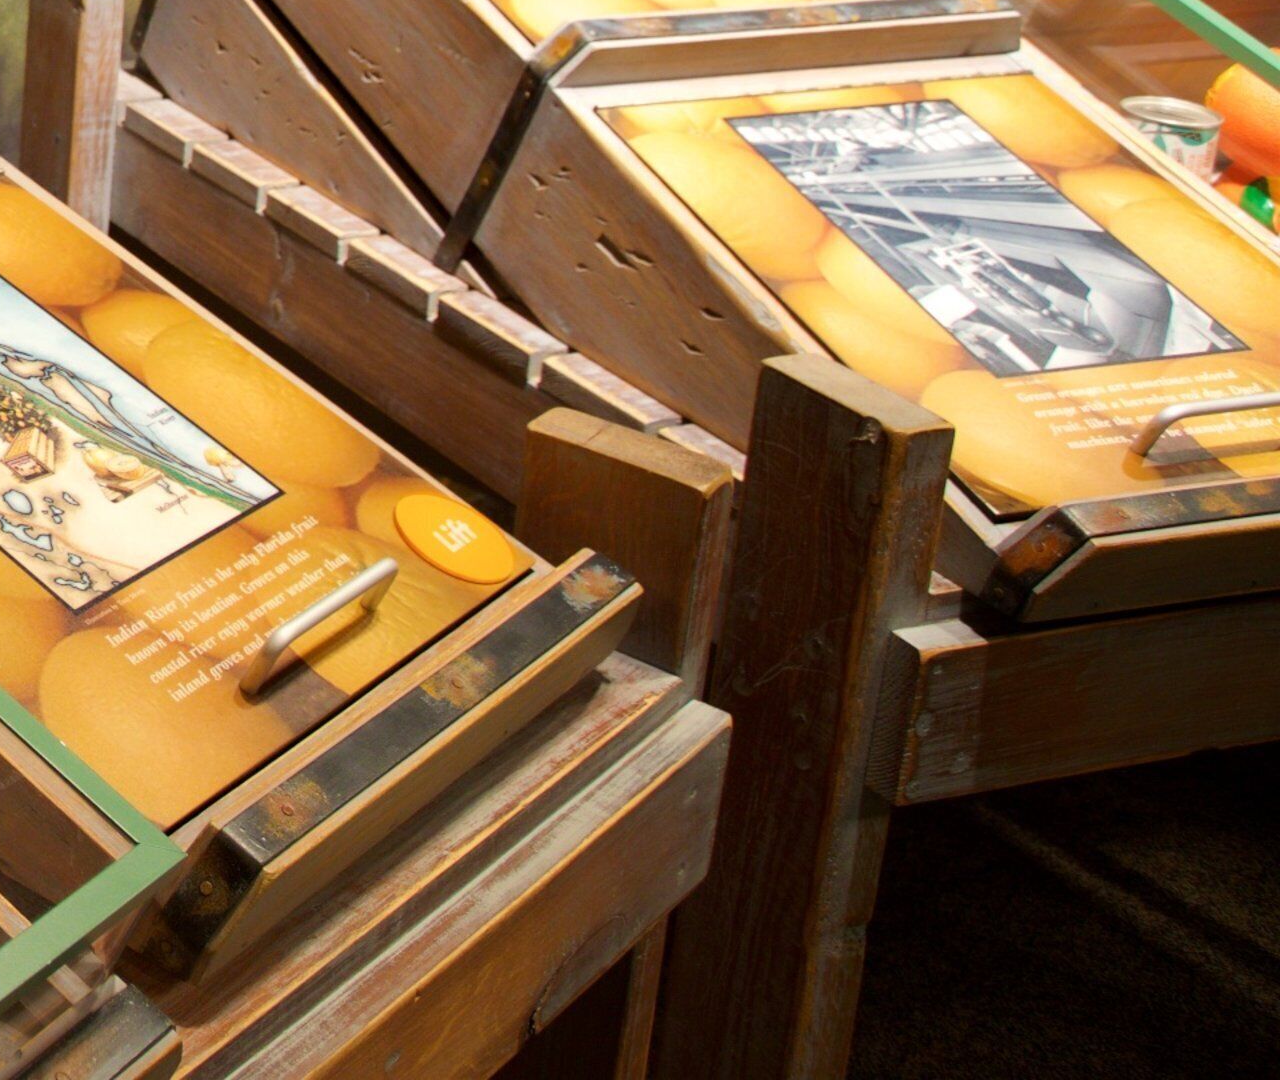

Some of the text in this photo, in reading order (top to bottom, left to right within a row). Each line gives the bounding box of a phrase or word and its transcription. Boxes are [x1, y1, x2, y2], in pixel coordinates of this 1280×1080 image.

[105, 618, 149, 647] Indian
[145, 600, 179, 623] River
[175, 581, 207, 607] fruit
[202, 576, 218, 588] is
[212, 566, 235, 582] the
[232, 552, 259, 571] only
[253, 529, 295, 557] Florida
[290, 512, 320, 537] fruit
[433, 519, 477, 553] Lift
[124, 547, 311, 665] known by its location. Groves on this
